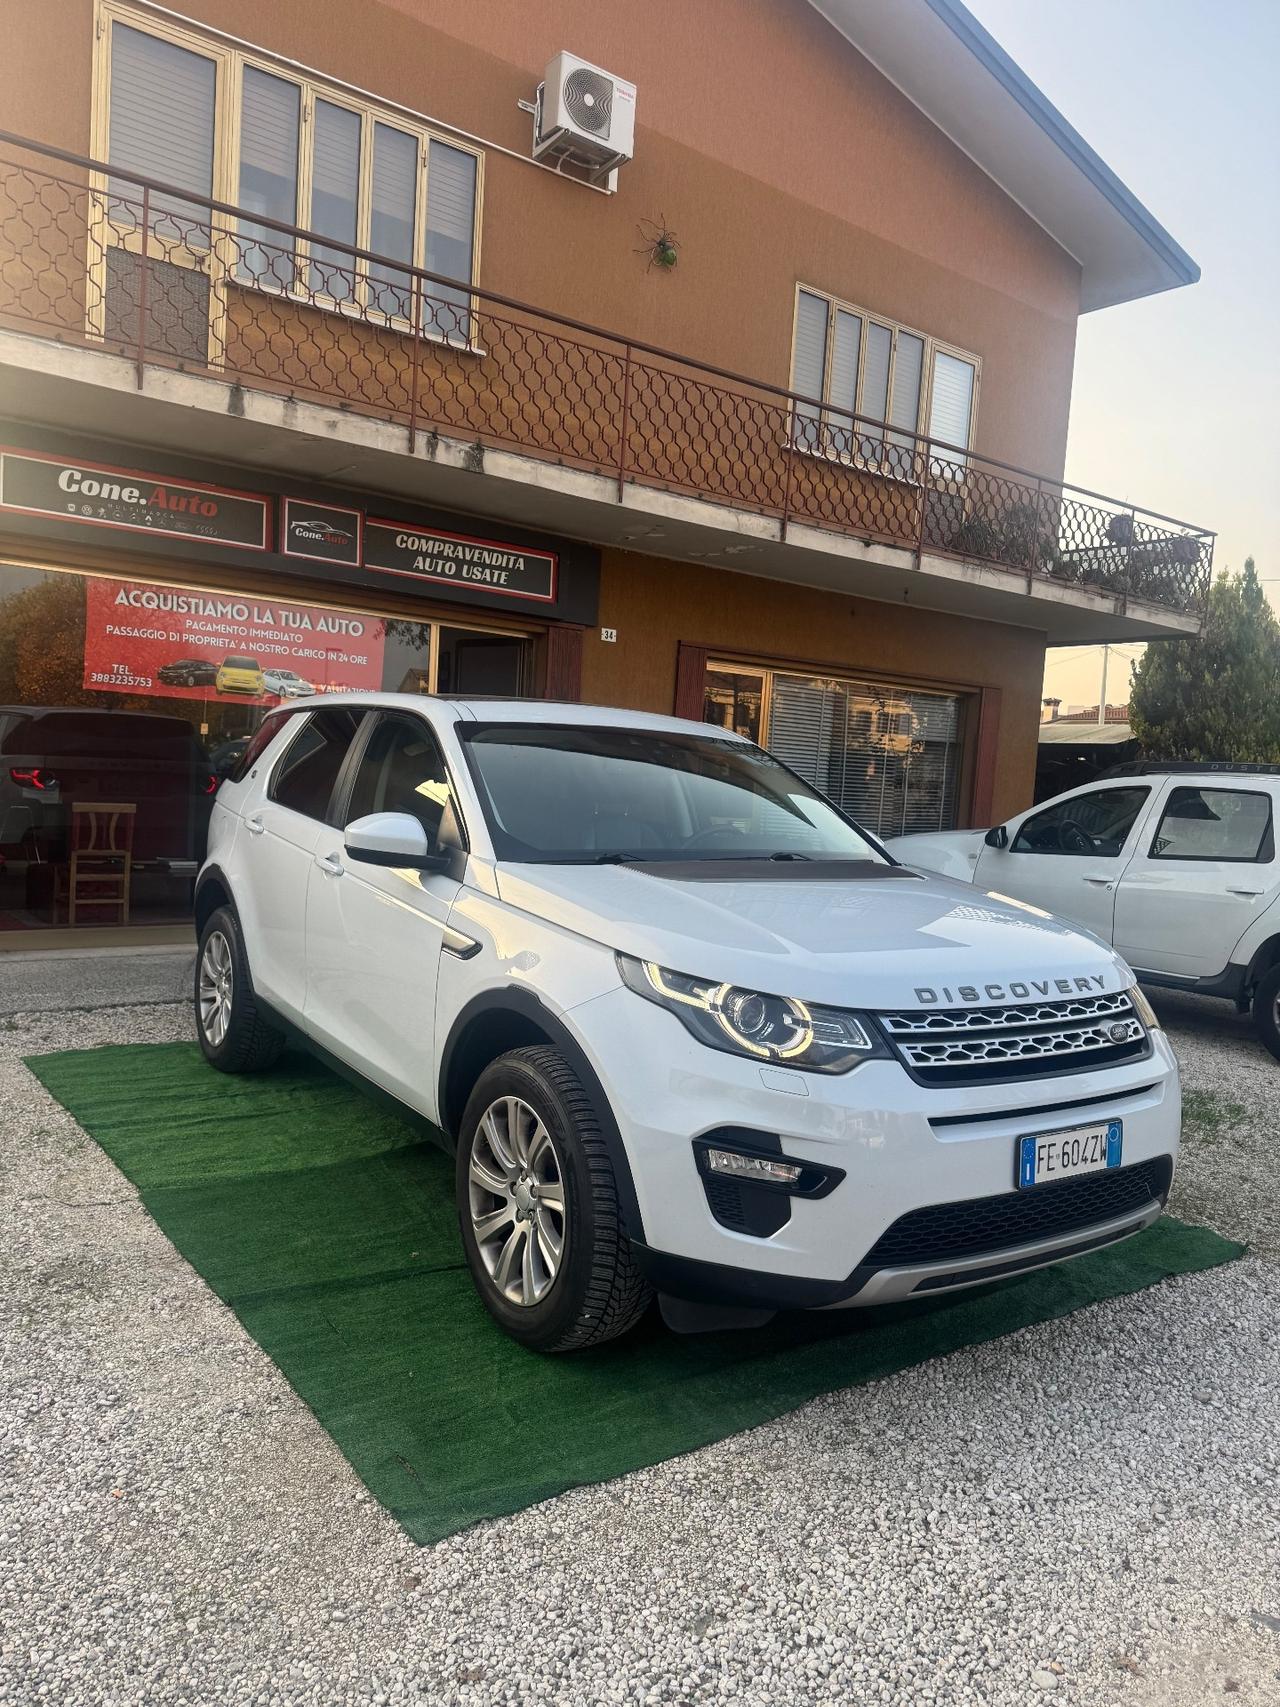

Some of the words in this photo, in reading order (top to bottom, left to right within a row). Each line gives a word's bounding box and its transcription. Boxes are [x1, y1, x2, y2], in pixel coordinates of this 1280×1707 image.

[58, 469, 217, 517] Cone.Auto
[295, 527, 348, 545] Cone.Auto
[396, 534, 525, 570] COMPRAVENDITA
[413, 556, 456, 575] AUTO
[462, 564, 509, 585] USATE
[114, 588, 249, 621] ACQUISTIAMO
[253, 607, 275, 625] LA
[279, 610, 313, 631] TUA
[316, 616, 364, 637] AUTO
[106, 625, 167, 641] PASSAGGIO
[169, 632, 180, 642] DI
[182, 633, 239, 649] PROPRIETA'
[239, 641, 247, 650] A
[249, 642, 290, 656] NOSTRO
[291, 647, 327, 660] CARICO
[327, 651, 338, 661] IN
[339, 653, 348, 662] 24
[349, 655, 368, 665] ORE
[186, 620, 248, 636] PAGAMENTO
[249, 628, 304, 643] IMMEDIATO
[604, 630, 614, 640] 34
[91, 672, 152, 687] 3883235753
[112, 664, 134, 675] TEL.
[914, 975, 1106, 1004] DISCOVERY
[1037, 1142, 1057, 1174] FE
[1061, 1133, 1108, 1169] 604ZW
